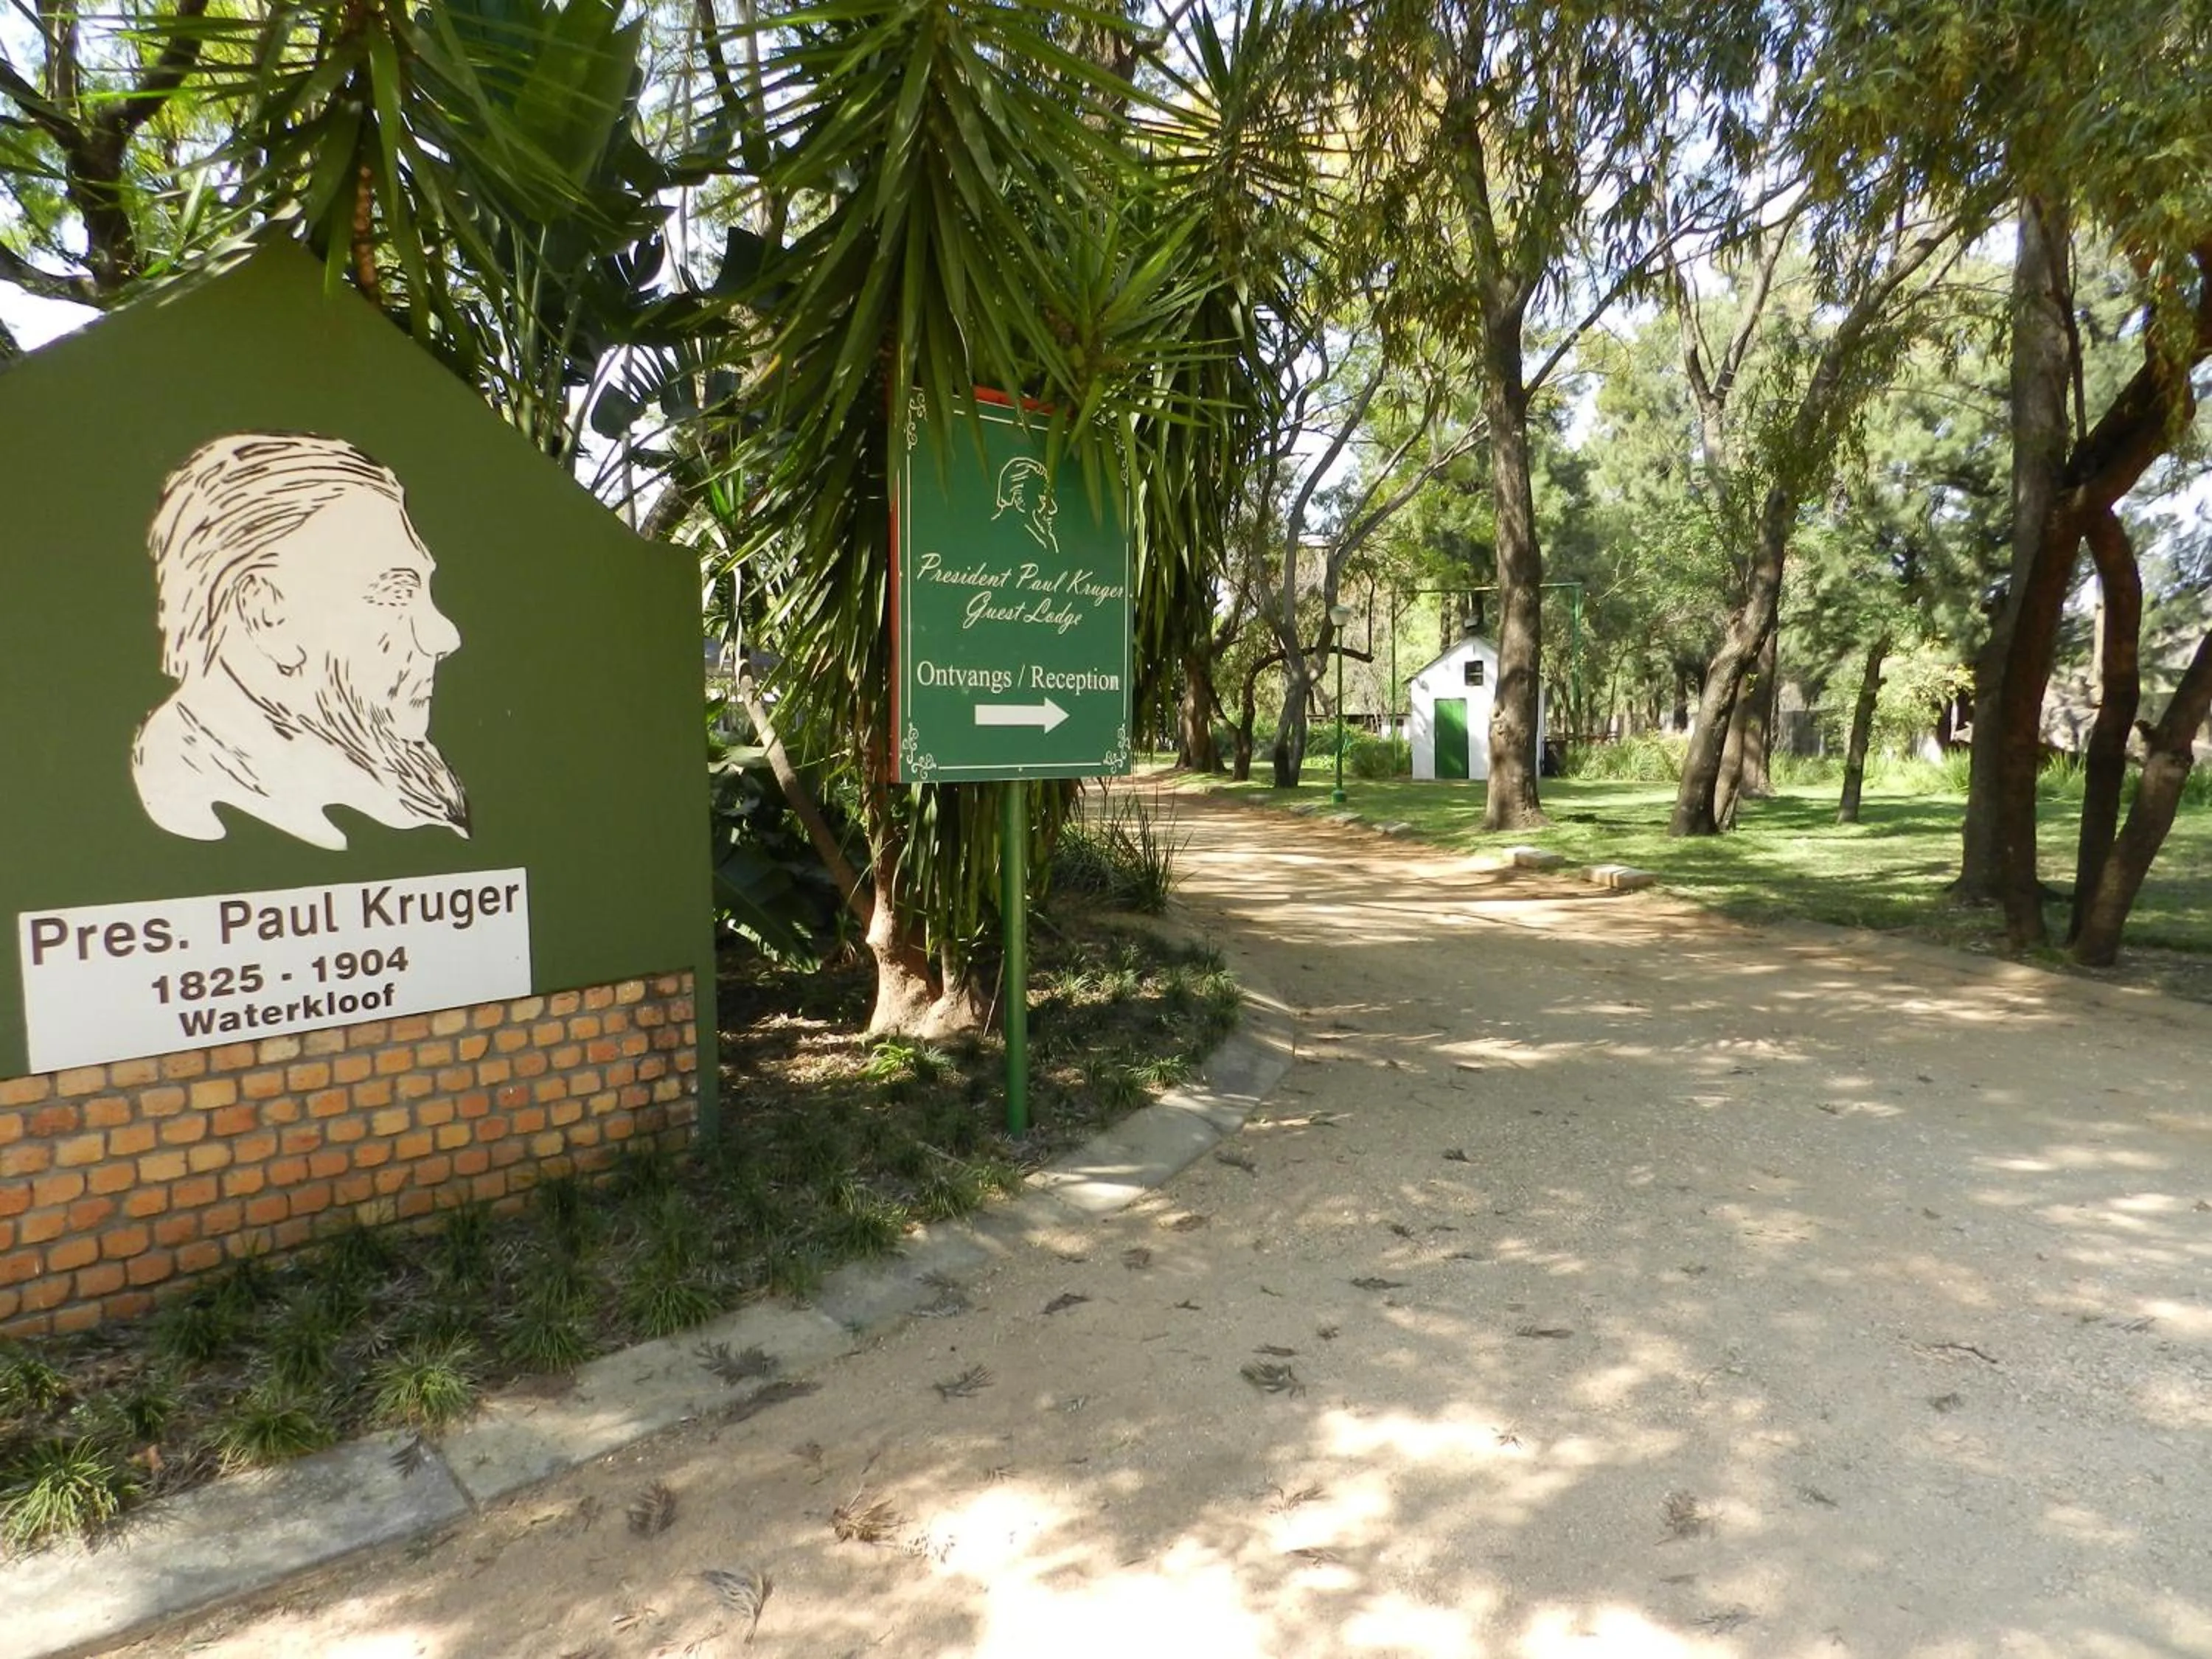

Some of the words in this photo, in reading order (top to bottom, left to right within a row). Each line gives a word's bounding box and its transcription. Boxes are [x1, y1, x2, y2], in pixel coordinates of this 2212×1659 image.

[917, 552, 1012, 588] President
[1015, 563, 1063, 594] Paul
[1066, 570, 1125, 606] Kruger
[963, 591, 1026, 628] Guest
[1026, 598, 1082, 634] Lodge
[917, 661, 1012, 694] Ontvangs
[1018, 663, 1026, 688] /
[1032, 665, 1120, 695] Reception
[30, 916, 189, 965] Pres.
[220, 891, 339, 945] Paul
[361, 883, 520, 931] Kruger
[151, 964, 264, 1004] 1825
[282, 972, 293, 981] -
[311, 946, 409, 984] 1904
[178, 983, 395, 1037] Waterkloof
